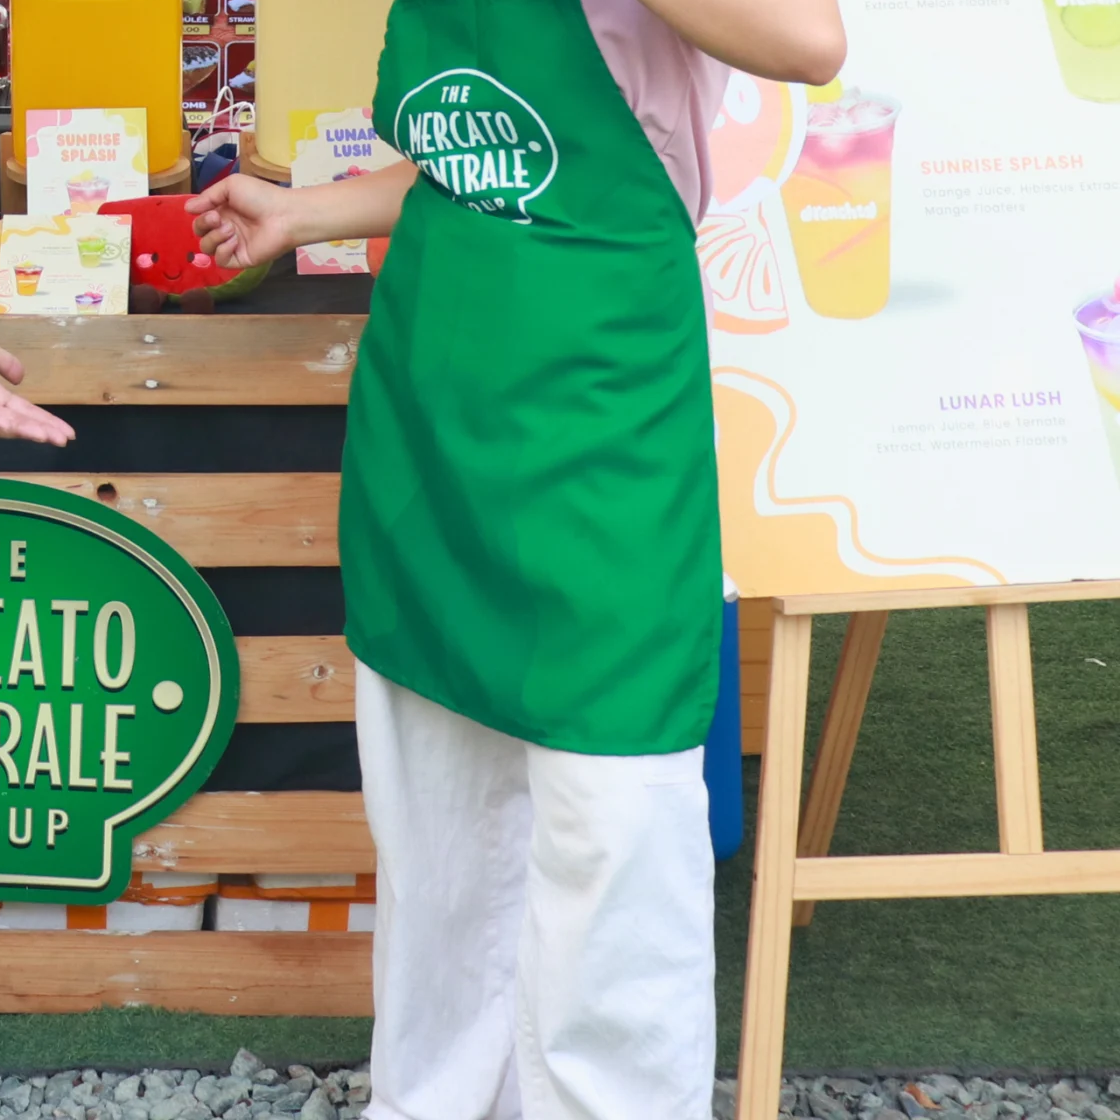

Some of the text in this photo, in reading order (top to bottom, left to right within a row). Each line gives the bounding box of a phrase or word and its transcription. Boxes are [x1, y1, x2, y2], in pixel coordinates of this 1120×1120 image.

[440, 85, 471, 104] THE
[56, 133, 121, 147] SUNRISE
[326, 127, 378, 143] LUNAR
[408, 110, 519, 155] MERCATO
[61, 148, 117, 162] SPLASH
[333, 144, 372, 158] LUSH
[920, 155, 1084, 176] SUNRISE SPLASH
[923, 187, 972, 200] Orange
[1019, 182, 1075, 195] Hibiscus
[1080, 180, 1120, 192] Extrac
[924, 202, 1026, 218] Mango Floaters
[939, 390, 1063, 411] LUNAR LUSH
[891, 422, 935, 434] Lemon
[982, 418, 1011, 430] Blue
[930, 437, 1011, 451] Watermelon
[1015, 434, 1069, 447] Floaters
